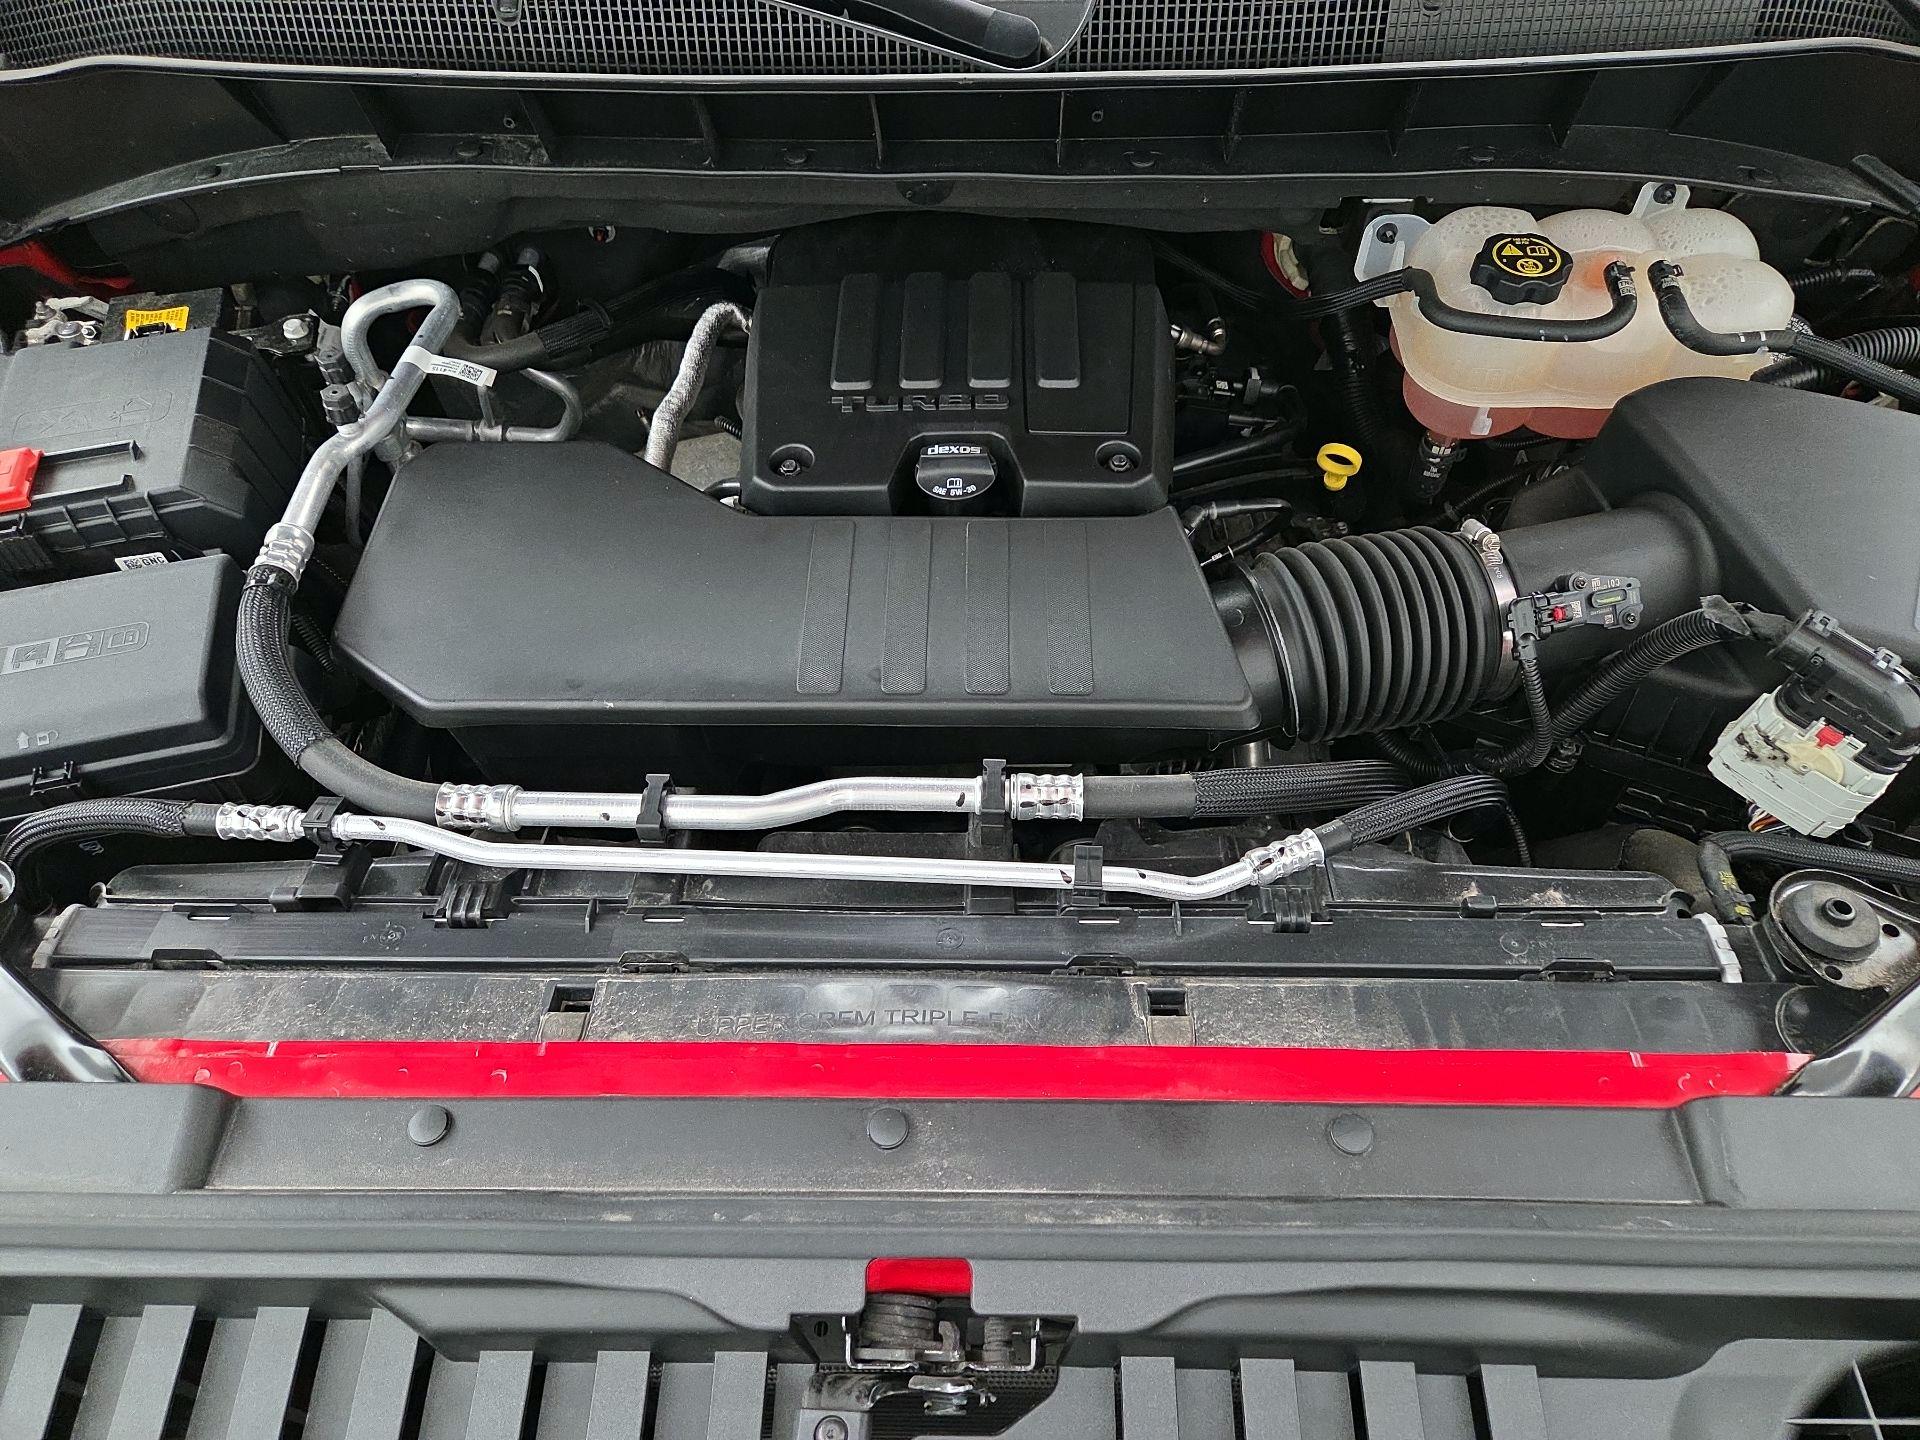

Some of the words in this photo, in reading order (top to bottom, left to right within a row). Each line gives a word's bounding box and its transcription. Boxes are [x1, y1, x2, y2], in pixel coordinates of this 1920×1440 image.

[831, 394, 1009, 412] TURBO
[927, 445, 981, 455] dexos
[932, 485, 947, 496] SAE
[950, 484, 977, 496] 5W-30
[884, 1009, 979, 1027] TRIPLE
